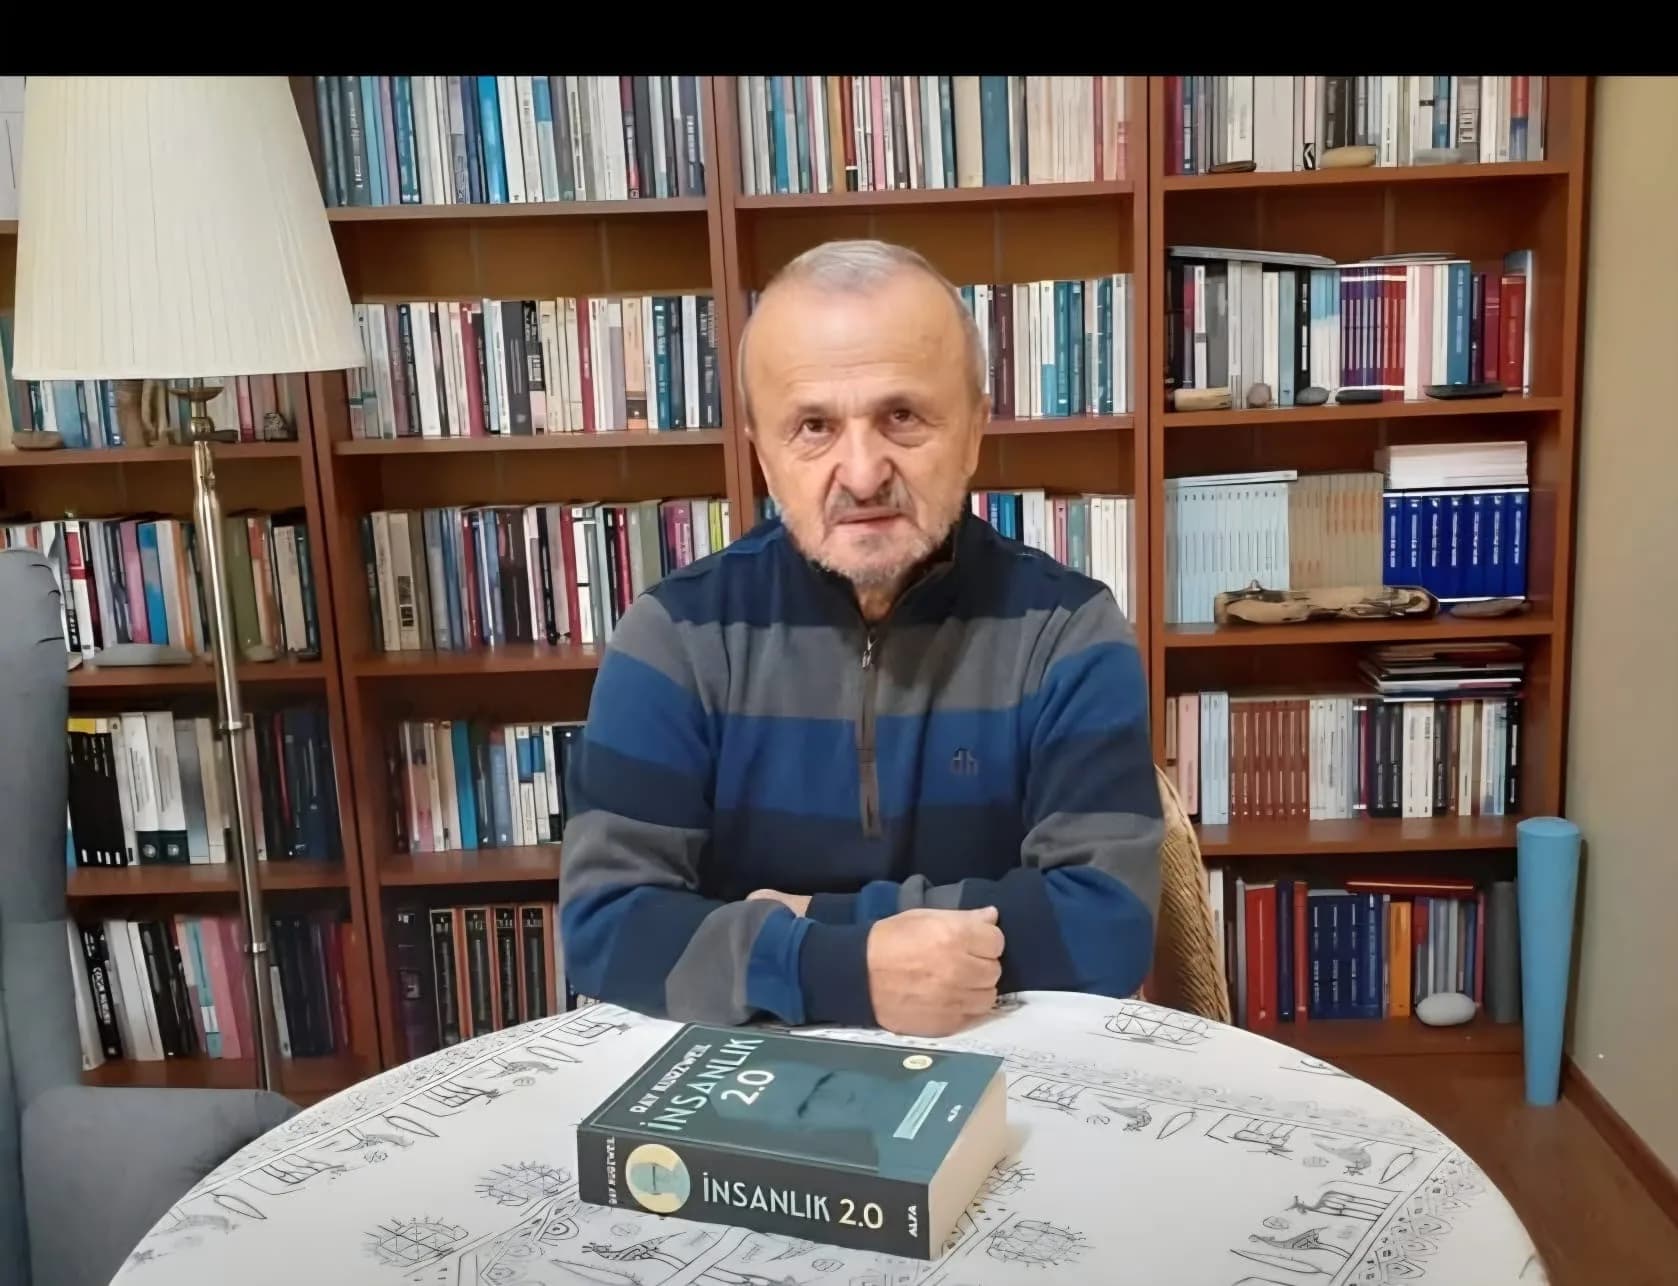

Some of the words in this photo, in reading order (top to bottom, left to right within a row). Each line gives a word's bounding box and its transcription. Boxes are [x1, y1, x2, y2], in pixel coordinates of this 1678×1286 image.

[640, 1038, 765, 1131] İNSANLIK
[720, 1070, 775, 1105] 2.0
[702, 1172, 830, 1222] İNSANLIK
[838, 1198, 884, 1230] 2.0
